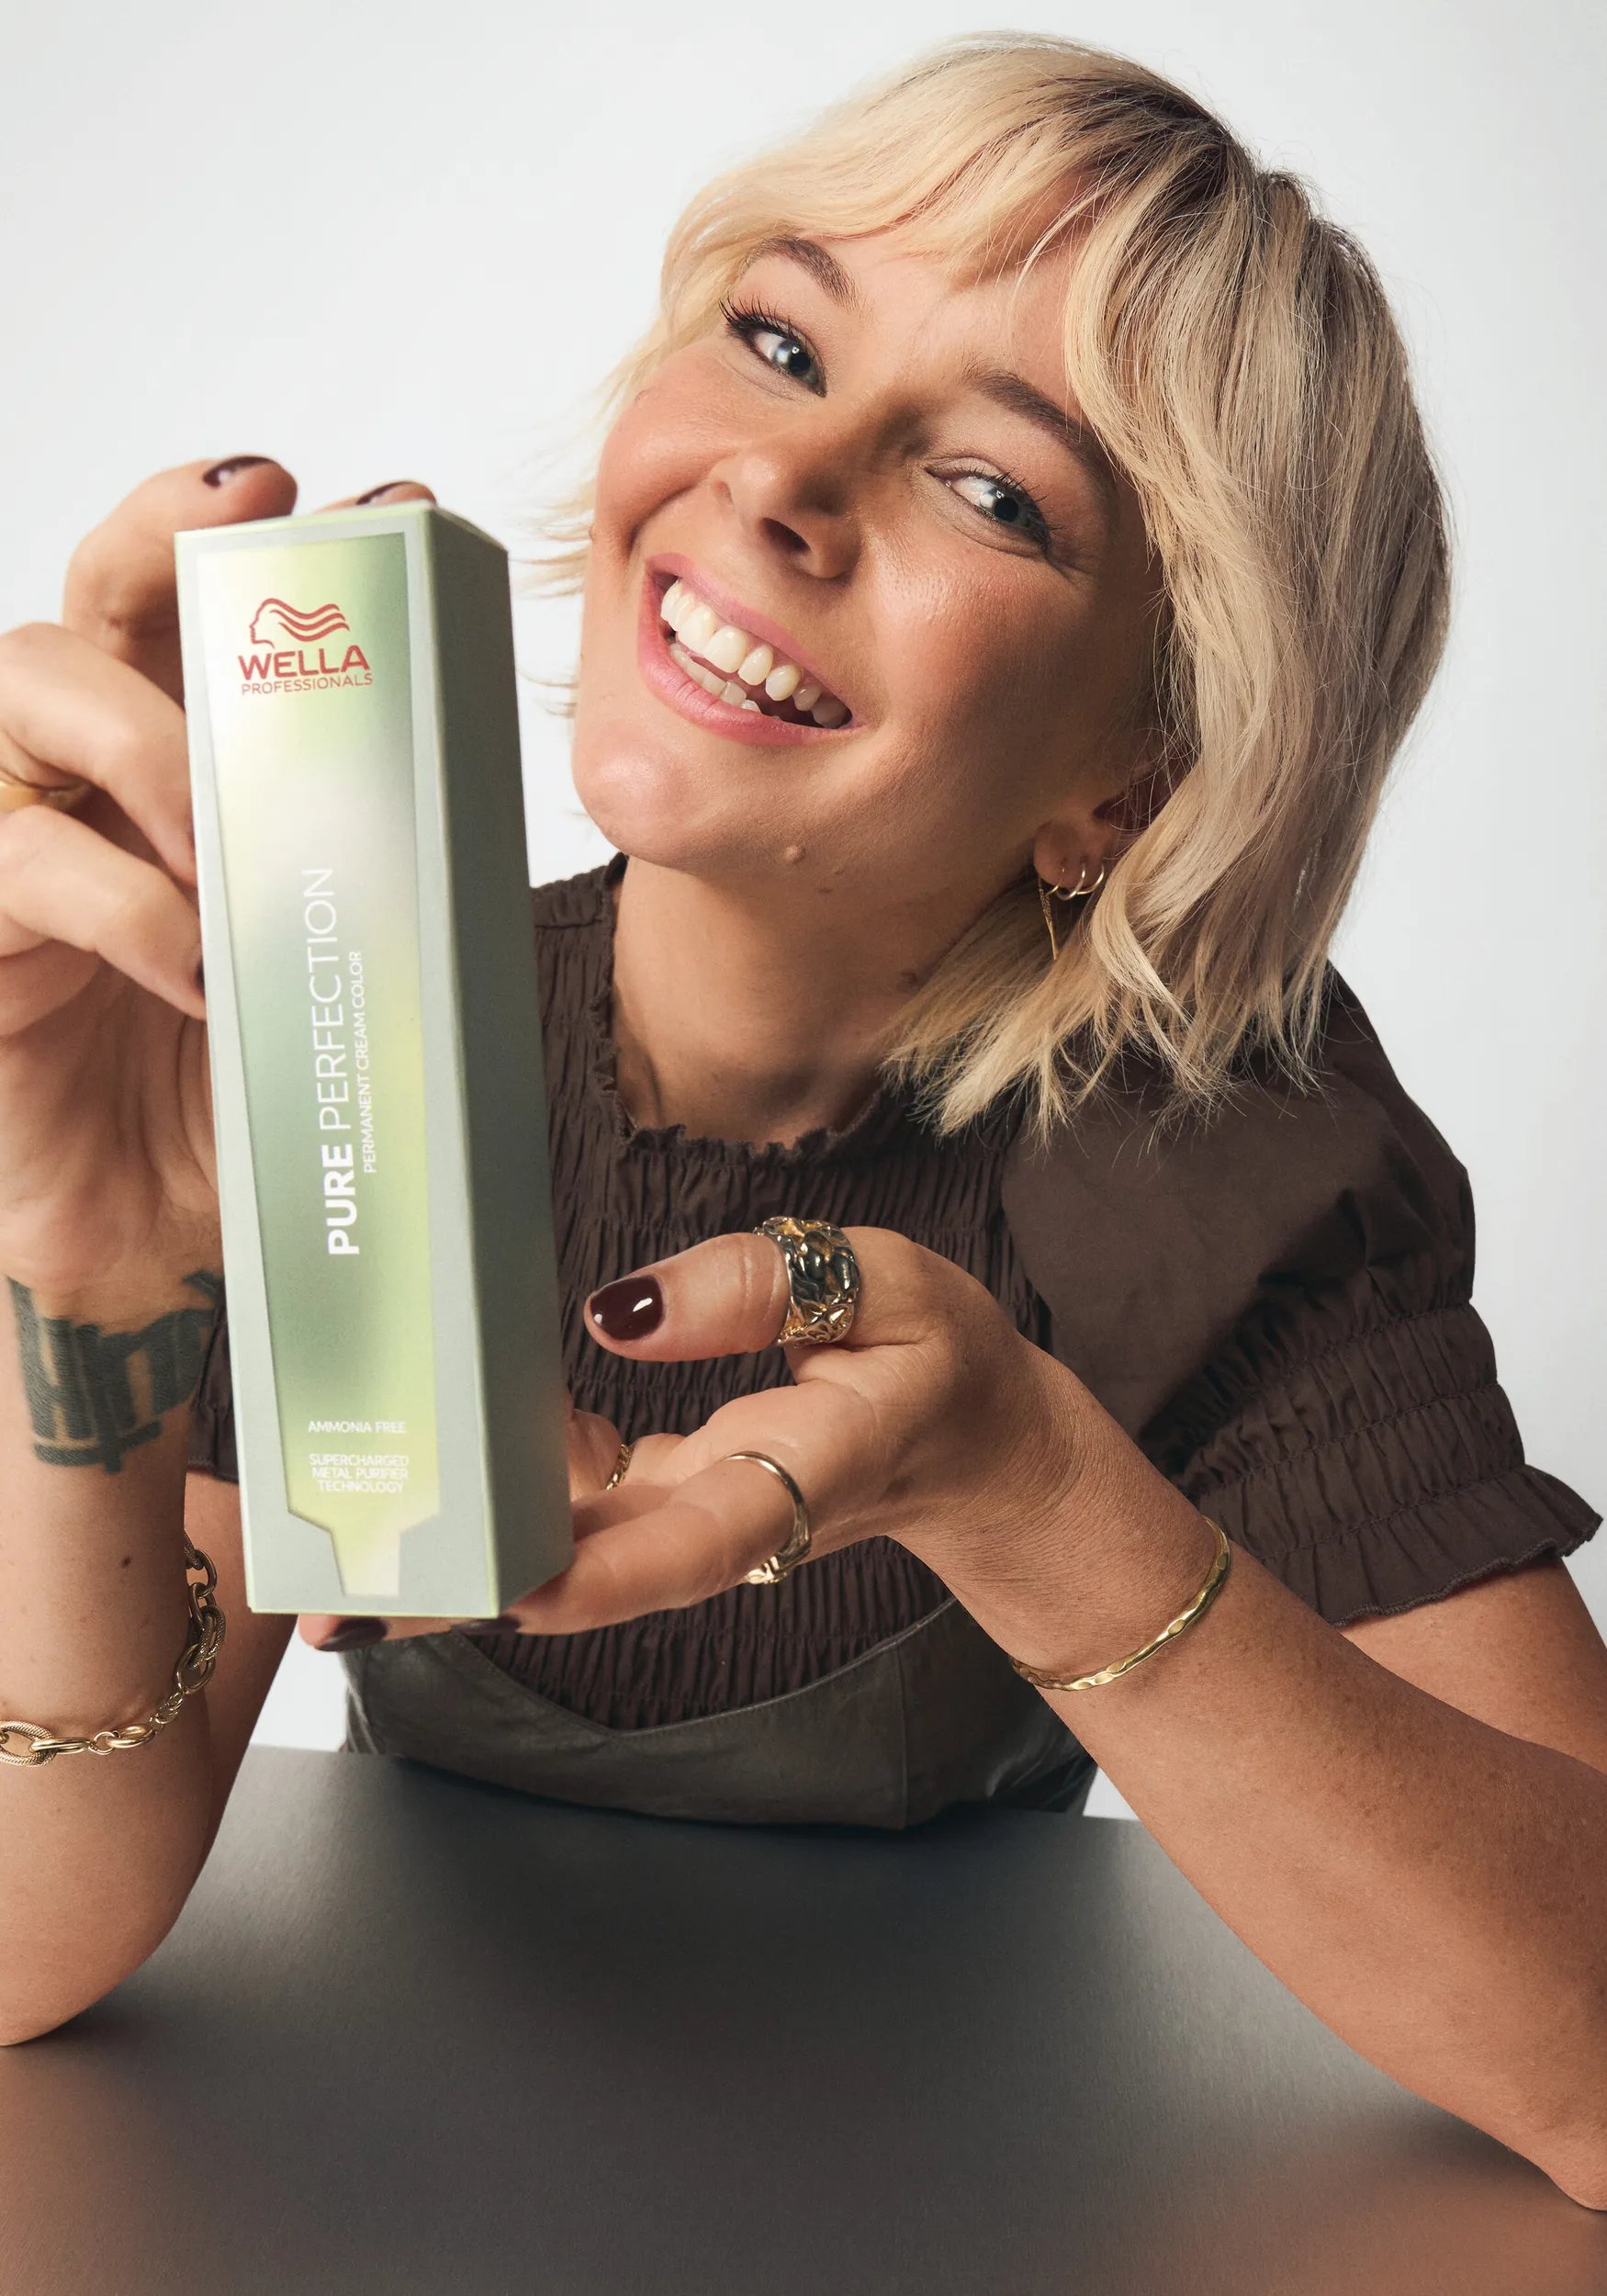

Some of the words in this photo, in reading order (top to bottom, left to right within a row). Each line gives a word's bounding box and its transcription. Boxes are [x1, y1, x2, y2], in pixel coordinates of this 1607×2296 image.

[237, 644, 371, 681] WELLA
[241, 672, 374, 696] PROFESSIONALS
[348, 951, 366, 1008] COLOR
[301, 868, 352, 1131] PERFECTION
[353, 1012, 370, 1071] CREAM
[355, 1075, 377, 1174] PERMANENT
[321, 1143, 360, 1255] PURE
[308, 1421, 372, 1433] AMMONIA
[376, 1421, 406, 1434] FREE
[309, 1454, 410, 1467] SUPERCHARGED
[312, 1468, 354, 1480] METAL
[356, 1468, 409, 1480] PURIFIER
[317, 1480, 404, 1493] TECHNOLOGY
